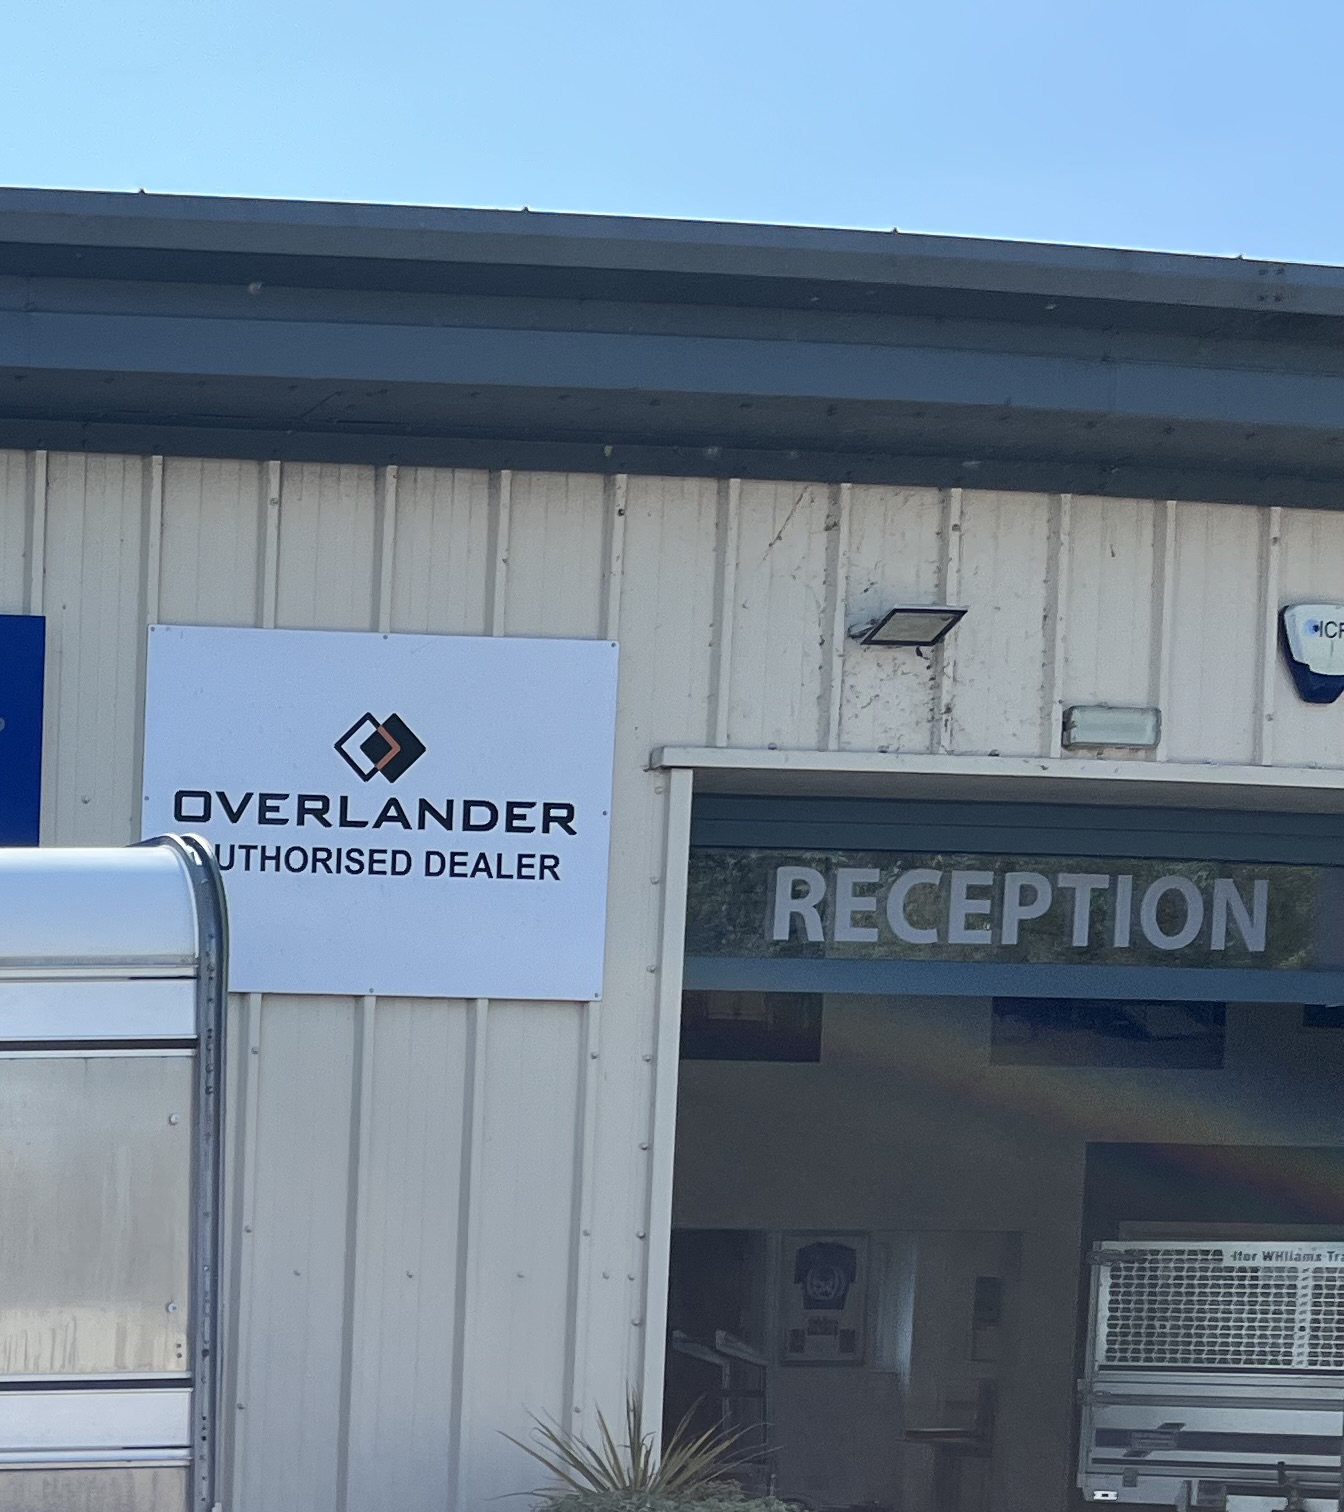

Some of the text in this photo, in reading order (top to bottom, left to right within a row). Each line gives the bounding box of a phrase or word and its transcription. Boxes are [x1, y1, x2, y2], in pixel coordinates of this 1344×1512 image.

[173, 789, 577, 836] OVERLANDER
[214, 843, 561, 881] UTHORISED DEALER
[771, 865, 1270, 953] RECEPTION
